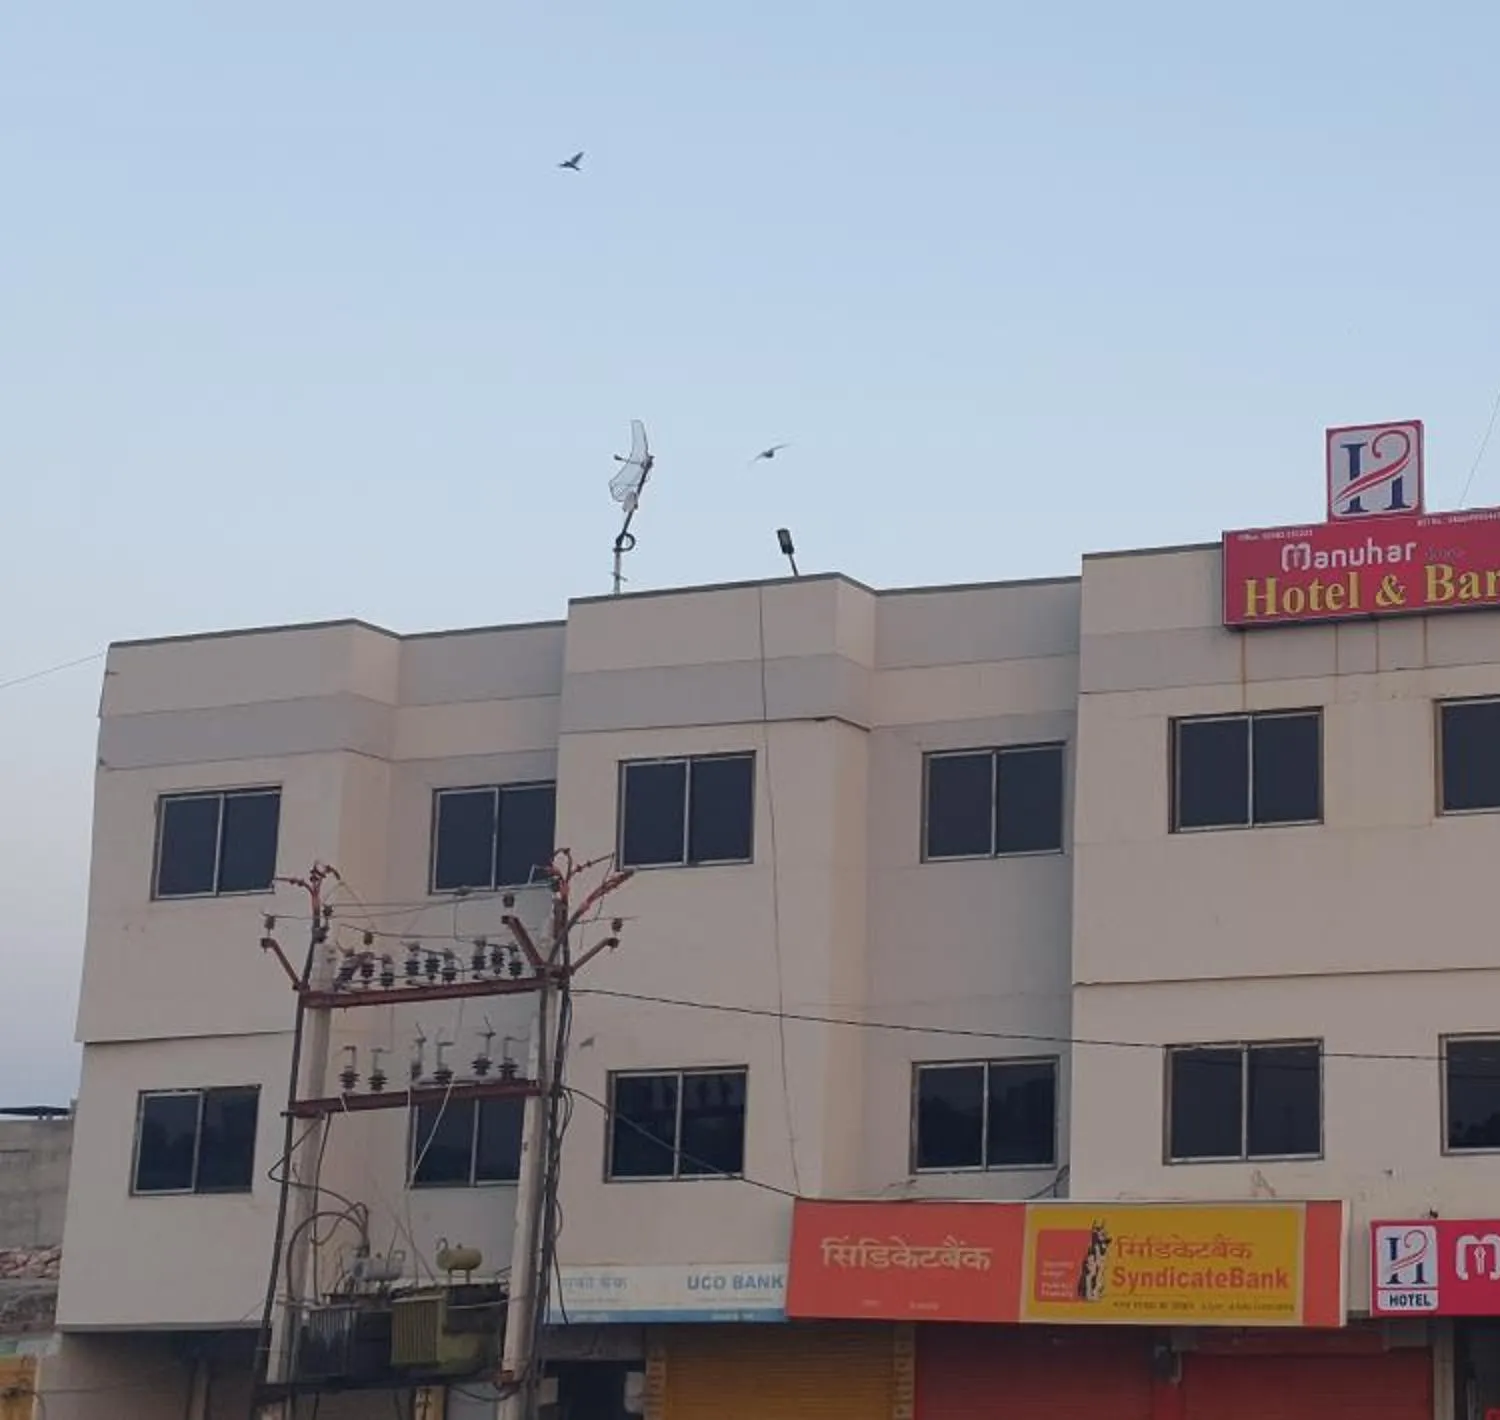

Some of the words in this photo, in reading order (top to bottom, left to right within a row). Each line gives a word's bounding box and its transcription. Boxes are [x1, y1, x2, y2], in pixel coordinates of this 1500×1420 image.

[1281, 538, 1417, 573] Manuhar
[1244, 572, 1360, 617] Hotel
[1375, 573, 1406, 607] &
[820, 1234, 993, 1273] सिंडिकेटबैंक
[687, 1275, 726, 1291] UCO
[732, 1274, 784, 1290] BANK
[1111, 1266, 1289, 1295] SyndicateBank
[1389, 1292, 1432, 1307] HOTEL
